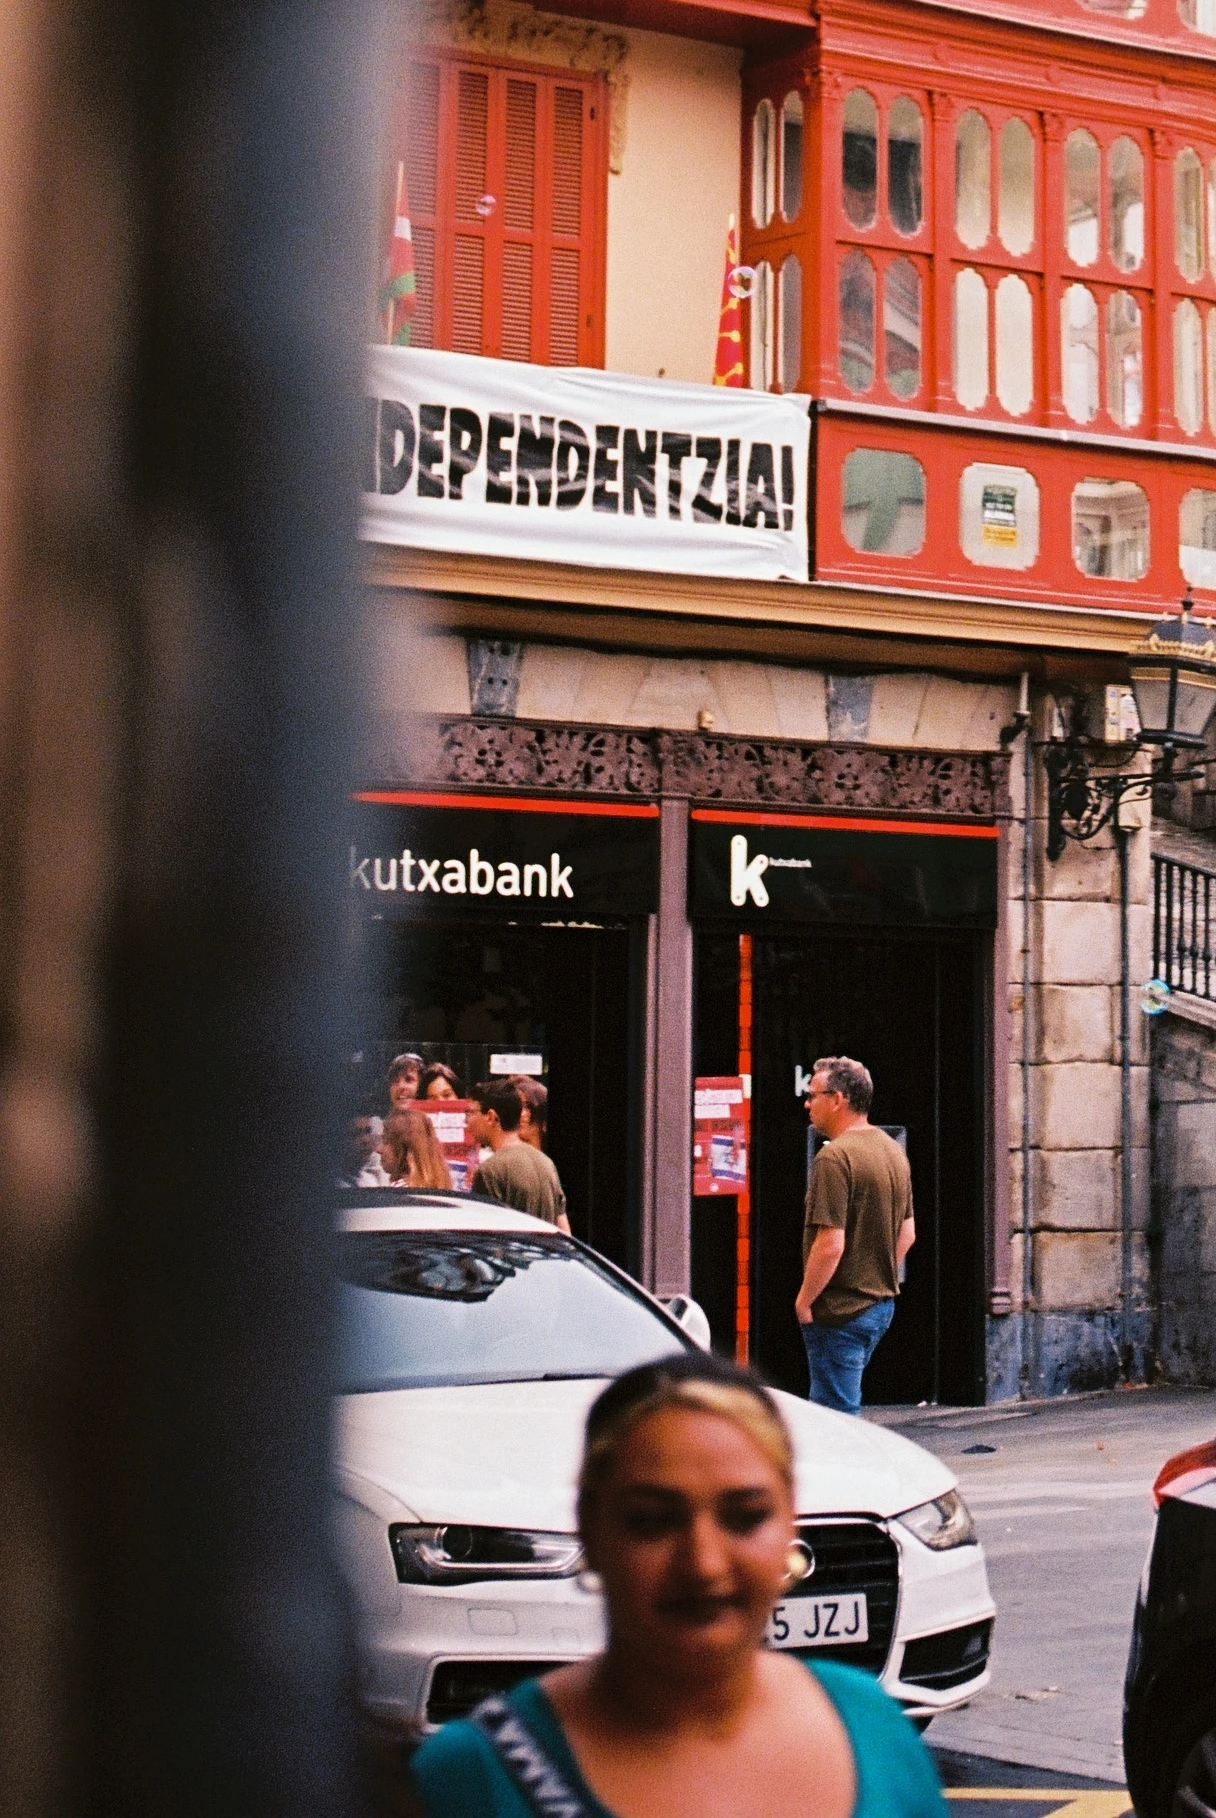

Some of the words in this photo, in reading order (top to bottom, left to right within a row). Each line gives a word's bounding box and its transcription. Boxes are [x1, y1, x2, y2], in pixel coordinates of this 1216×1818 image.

[350, 846, 575, 899] kutxabank
[730, 834, 770, 908] k
[803, 1600, 860, 1639] JZJ
